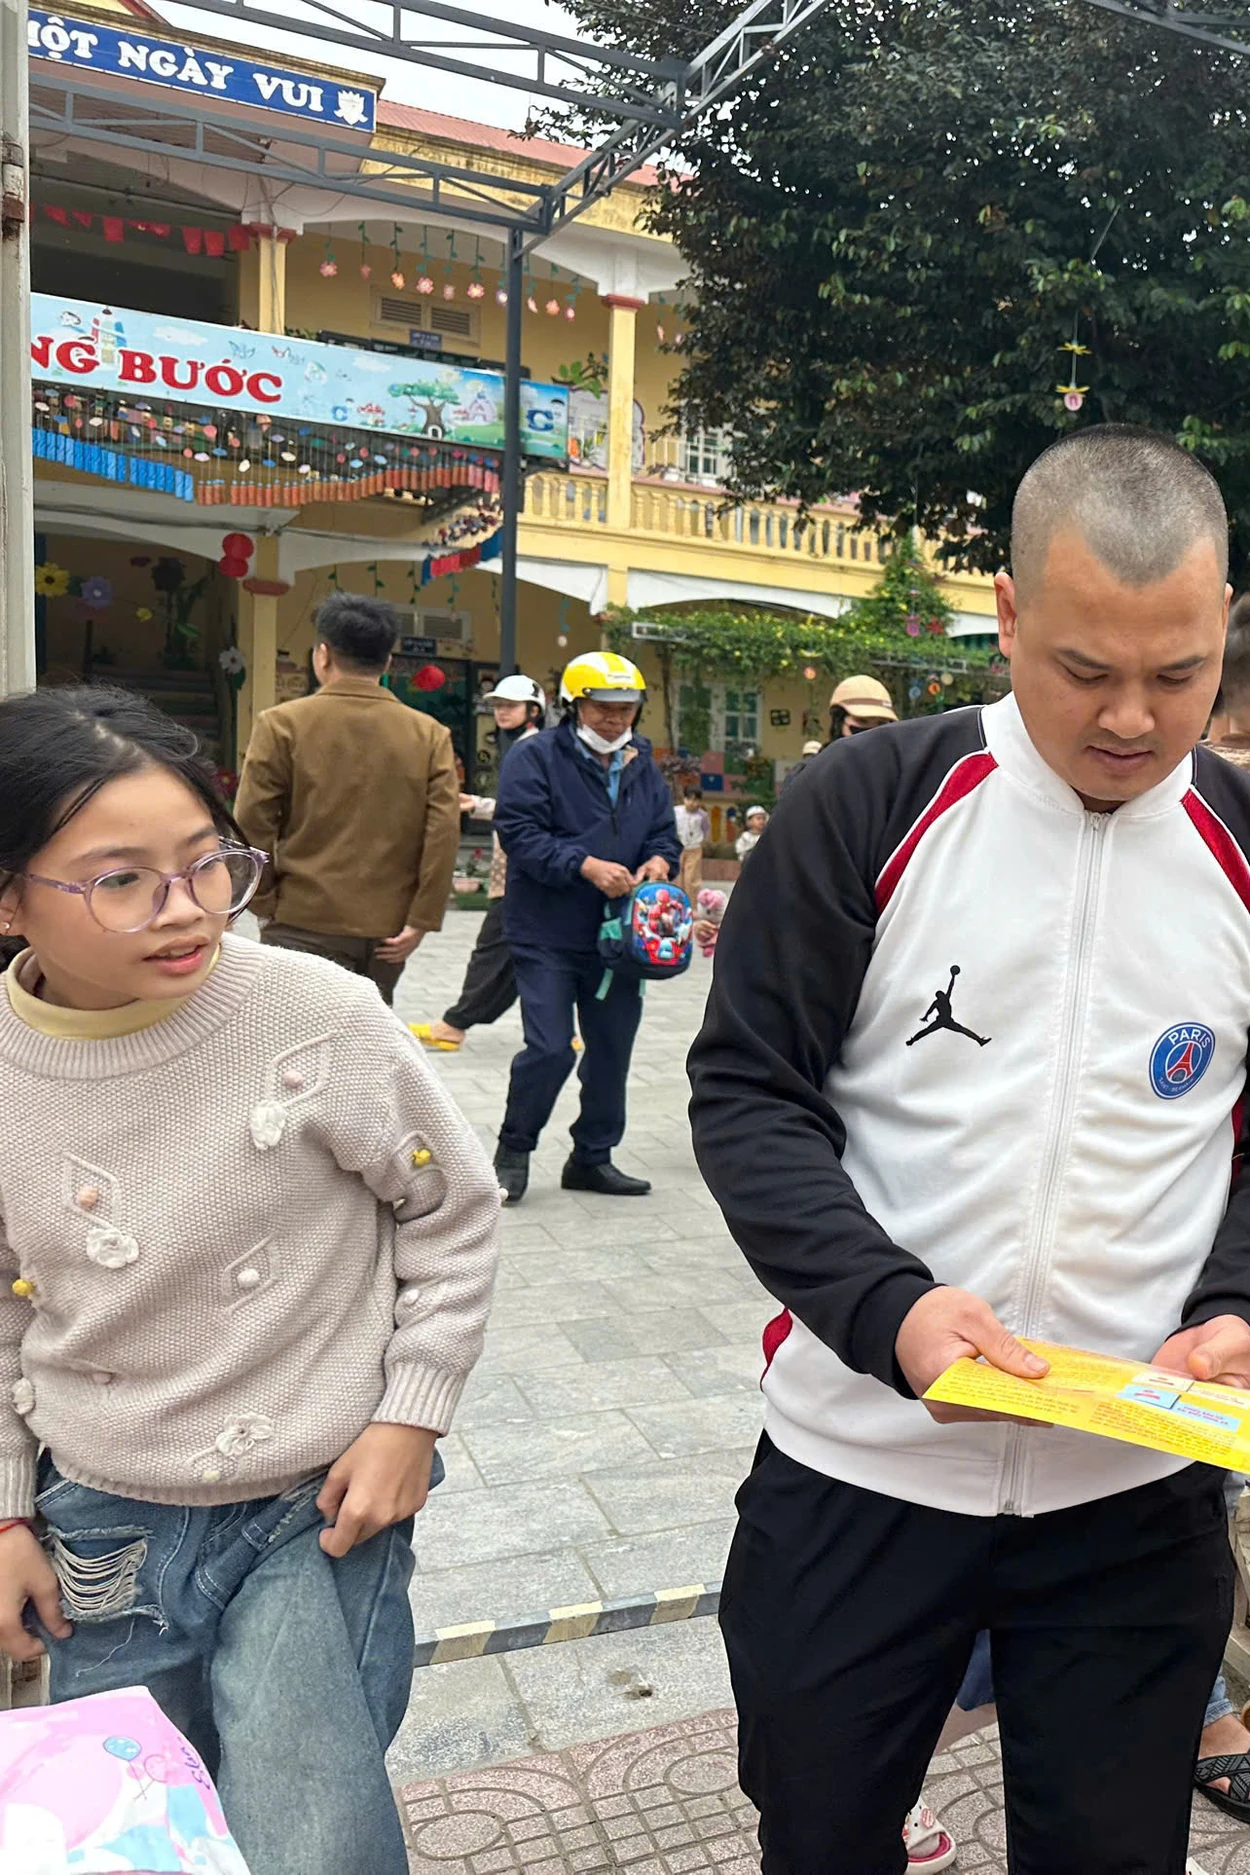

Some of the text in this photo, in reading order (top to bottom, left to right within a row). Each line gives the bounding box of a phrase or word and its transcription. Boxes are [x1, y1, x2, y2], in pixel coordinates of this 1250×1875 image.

[118, 41, 234, 90] NGÀY
[253, 73, 324, 112] VUI
[118, 350, 282, 403] BƯỚC
[1168, 1028, 1210, 1048] PARIS
